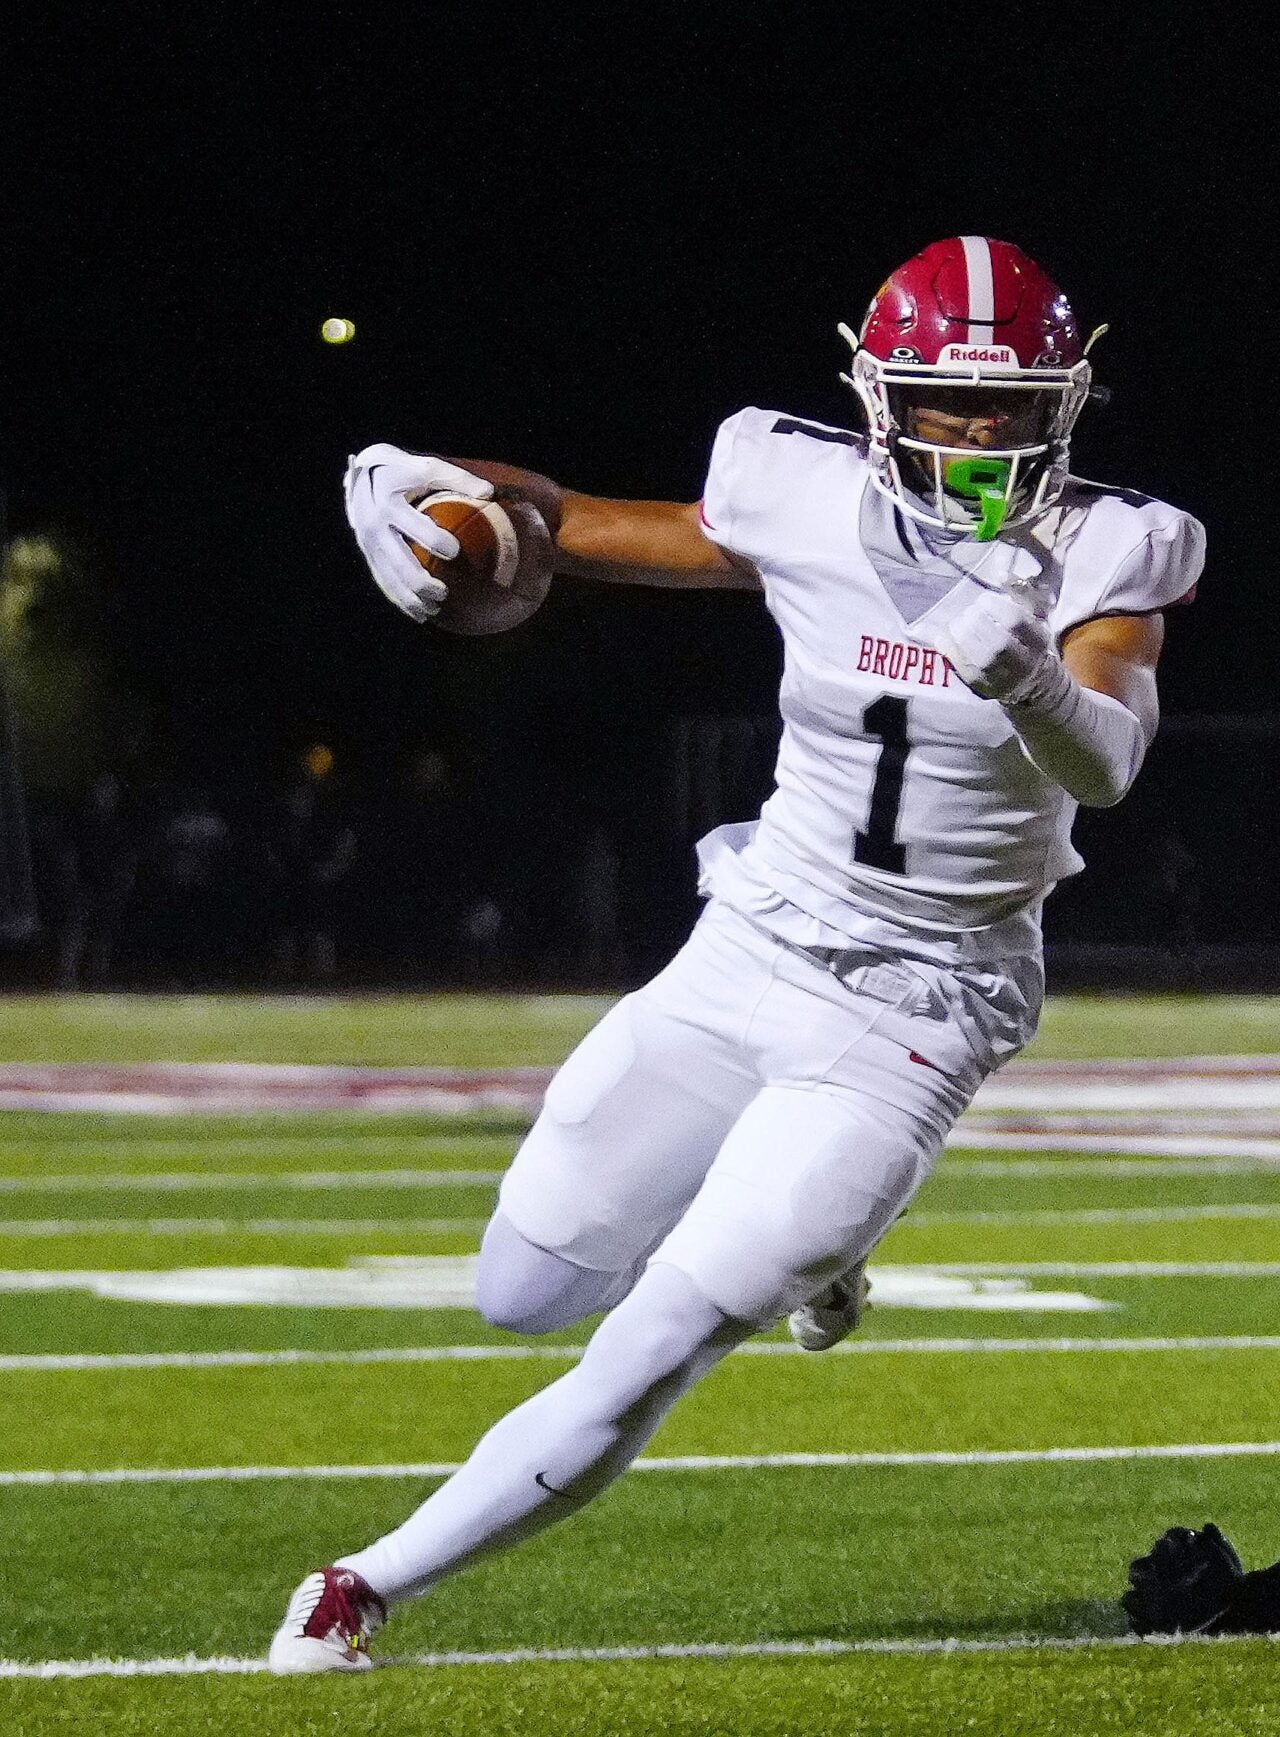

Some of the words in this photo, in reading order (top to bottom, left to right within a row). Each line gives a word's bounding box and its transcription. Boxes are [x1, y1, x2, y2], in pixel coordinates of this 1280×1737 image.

[949, 347, 1010, 363] Riddell
[856, 635, 956, 688] BROPHY
[853, 694, 910, 875] 1
